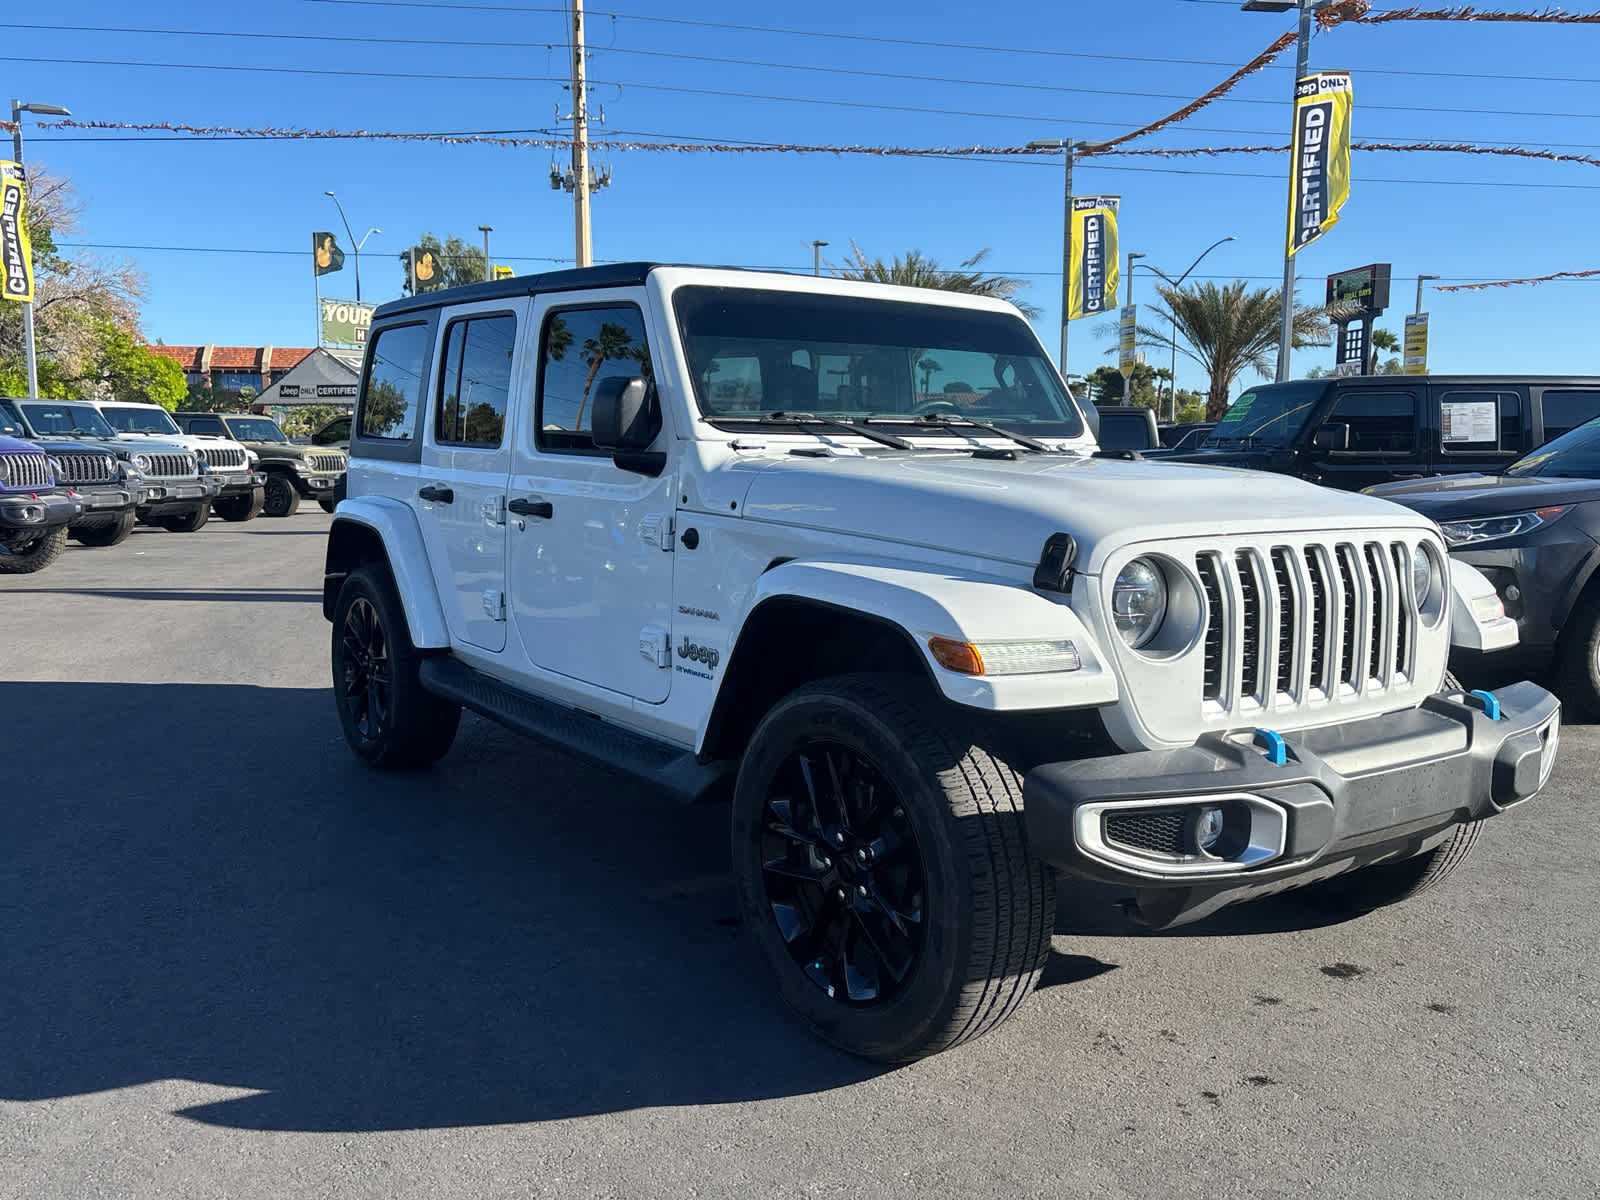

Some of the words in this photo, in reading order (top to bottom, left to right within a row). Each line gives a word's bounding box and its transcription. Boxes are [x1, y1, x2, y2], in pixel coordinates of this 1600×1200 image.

[1296, 83, 1317, 96] eep
[1320, 77, 1348, 89] ONLY
[1075, 199, 1096, 210] Jeep
[1097, 199, 1118, 208] ONLY
[1087, 217, 1101, 311] CERTIFIED
[325, 304, 372, 326] YOUR
[281, 387, 298, 396] Jeep
[300, 387, 316, 395] ONLY
[318, 386, 358, 395] CERTIFIED
[678, 636, 719, 670] Jeep
